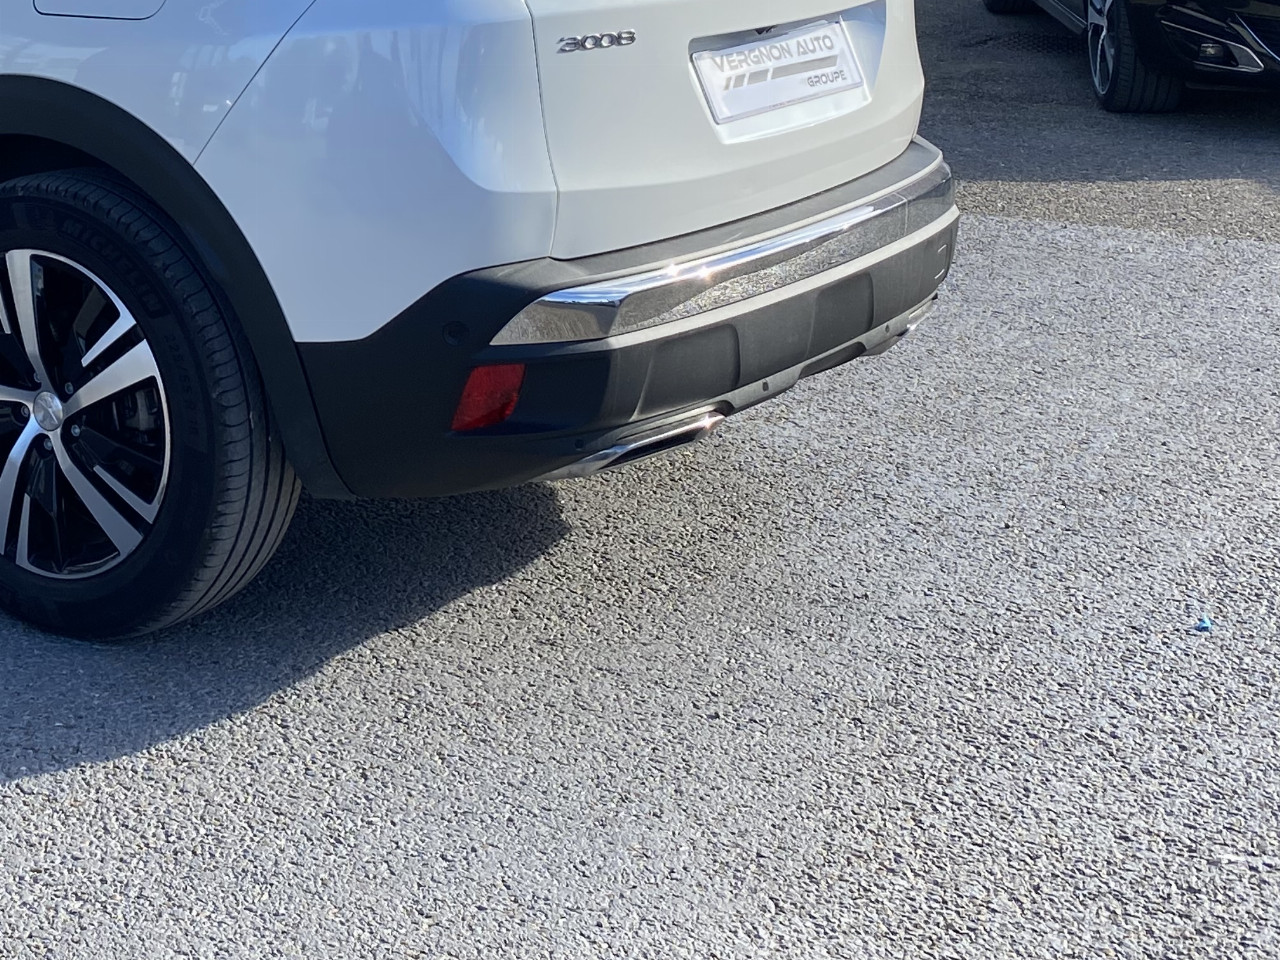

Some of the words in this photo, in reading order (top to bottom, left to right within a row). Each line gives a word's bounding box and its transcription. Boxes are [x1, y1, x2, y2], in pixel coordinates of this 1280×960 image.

[556, 28, 636, 54] 3008
[711, 42, 794, 73] VERGNON
[797, 34, 834, 56] AUTO
[807, 70, 847, 87] GROUPE
